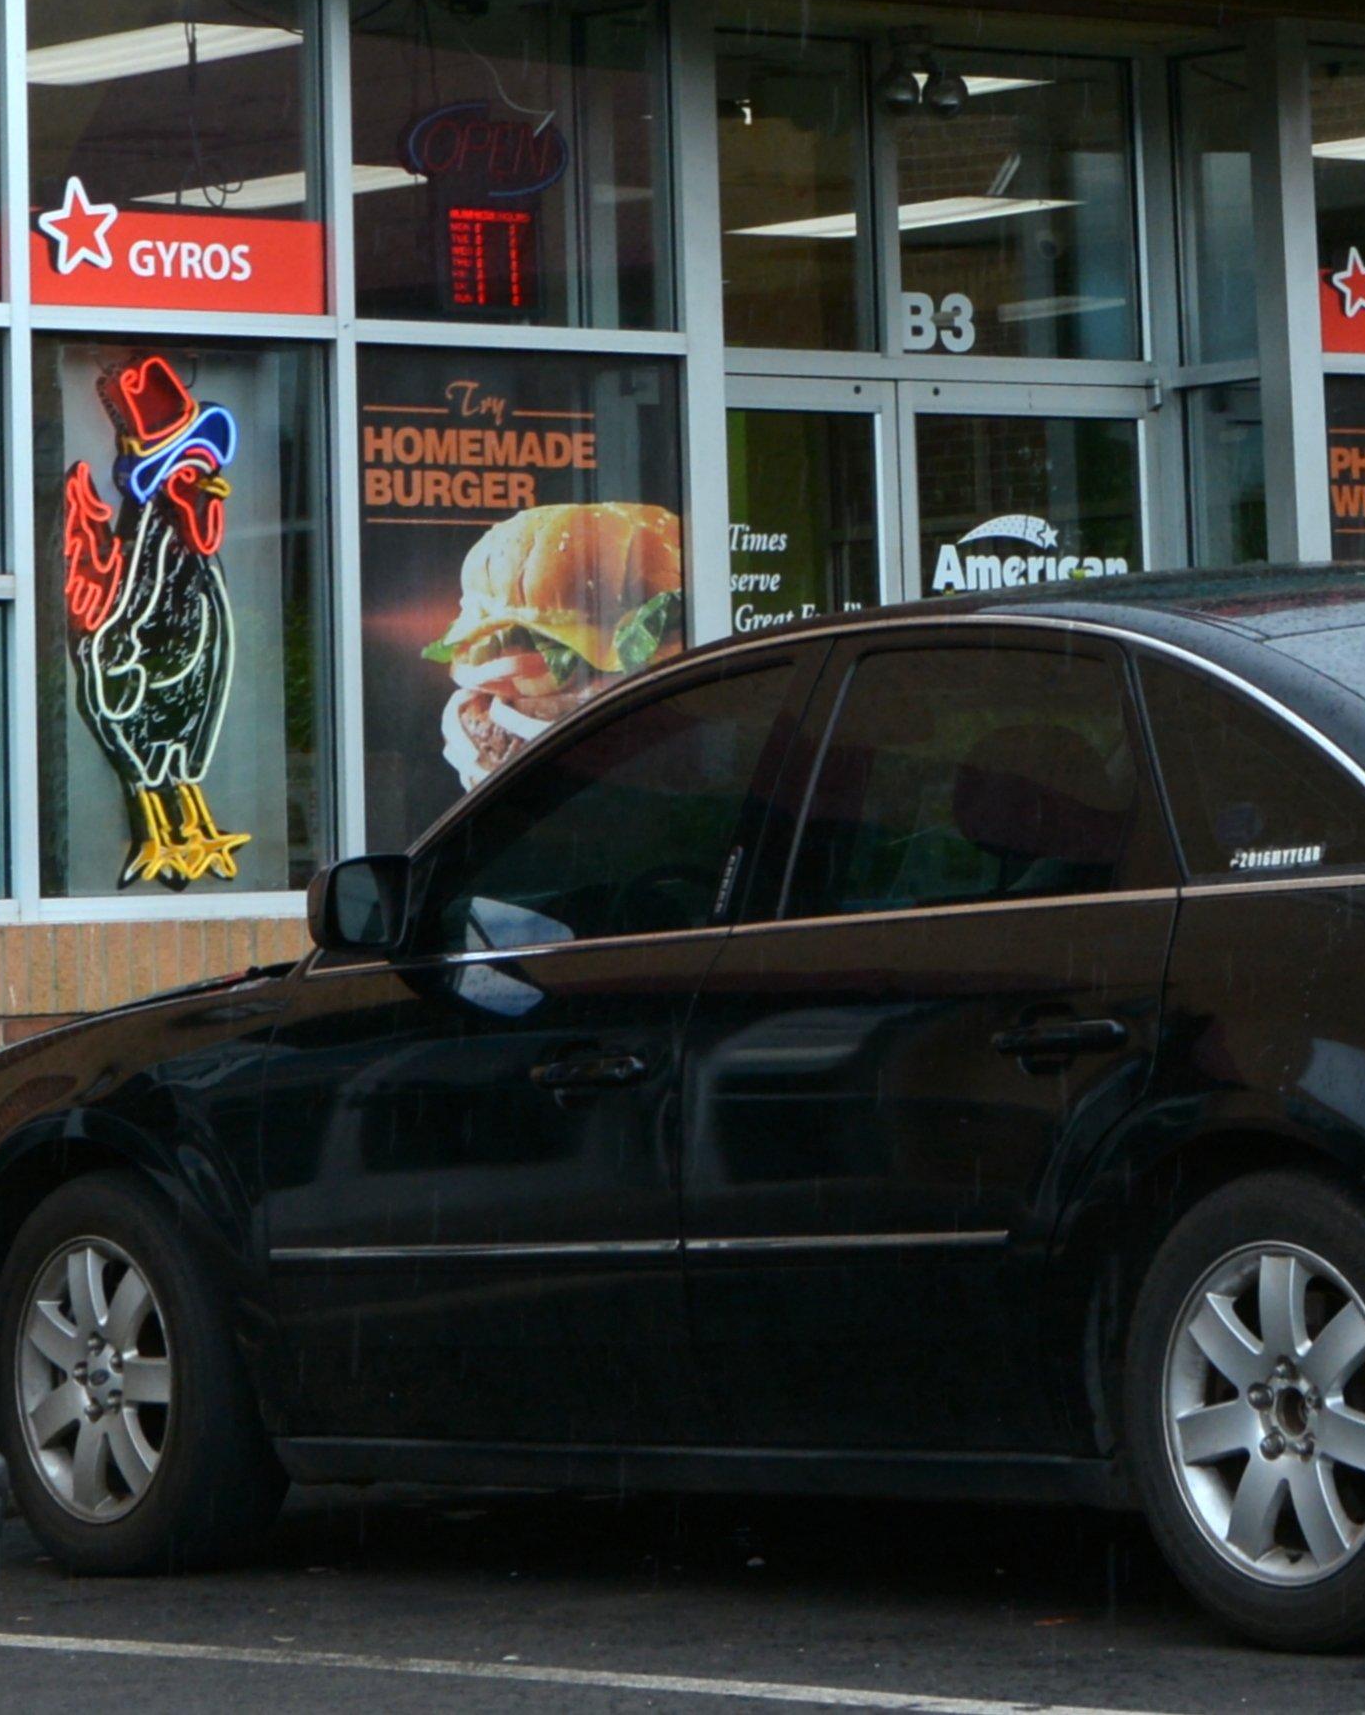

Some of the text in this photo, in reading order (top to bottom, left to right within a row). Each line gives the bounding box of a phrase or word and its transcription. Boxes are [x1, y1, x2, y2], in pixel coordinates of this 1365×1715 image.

[424, 117, 553, 178] OPEN
[127, 239, 252, 282] GYROS
[902, 292, 976, 353] B3
[444, 380, 507, 426] Try
[362, 425, 597, 469] HOMEMADE
[364, 469, 536, 509] BURGER
[729, 522, 788, 552] Times
[730, 572, 781, 592] serve
[931, 543, 1129, 591] American
